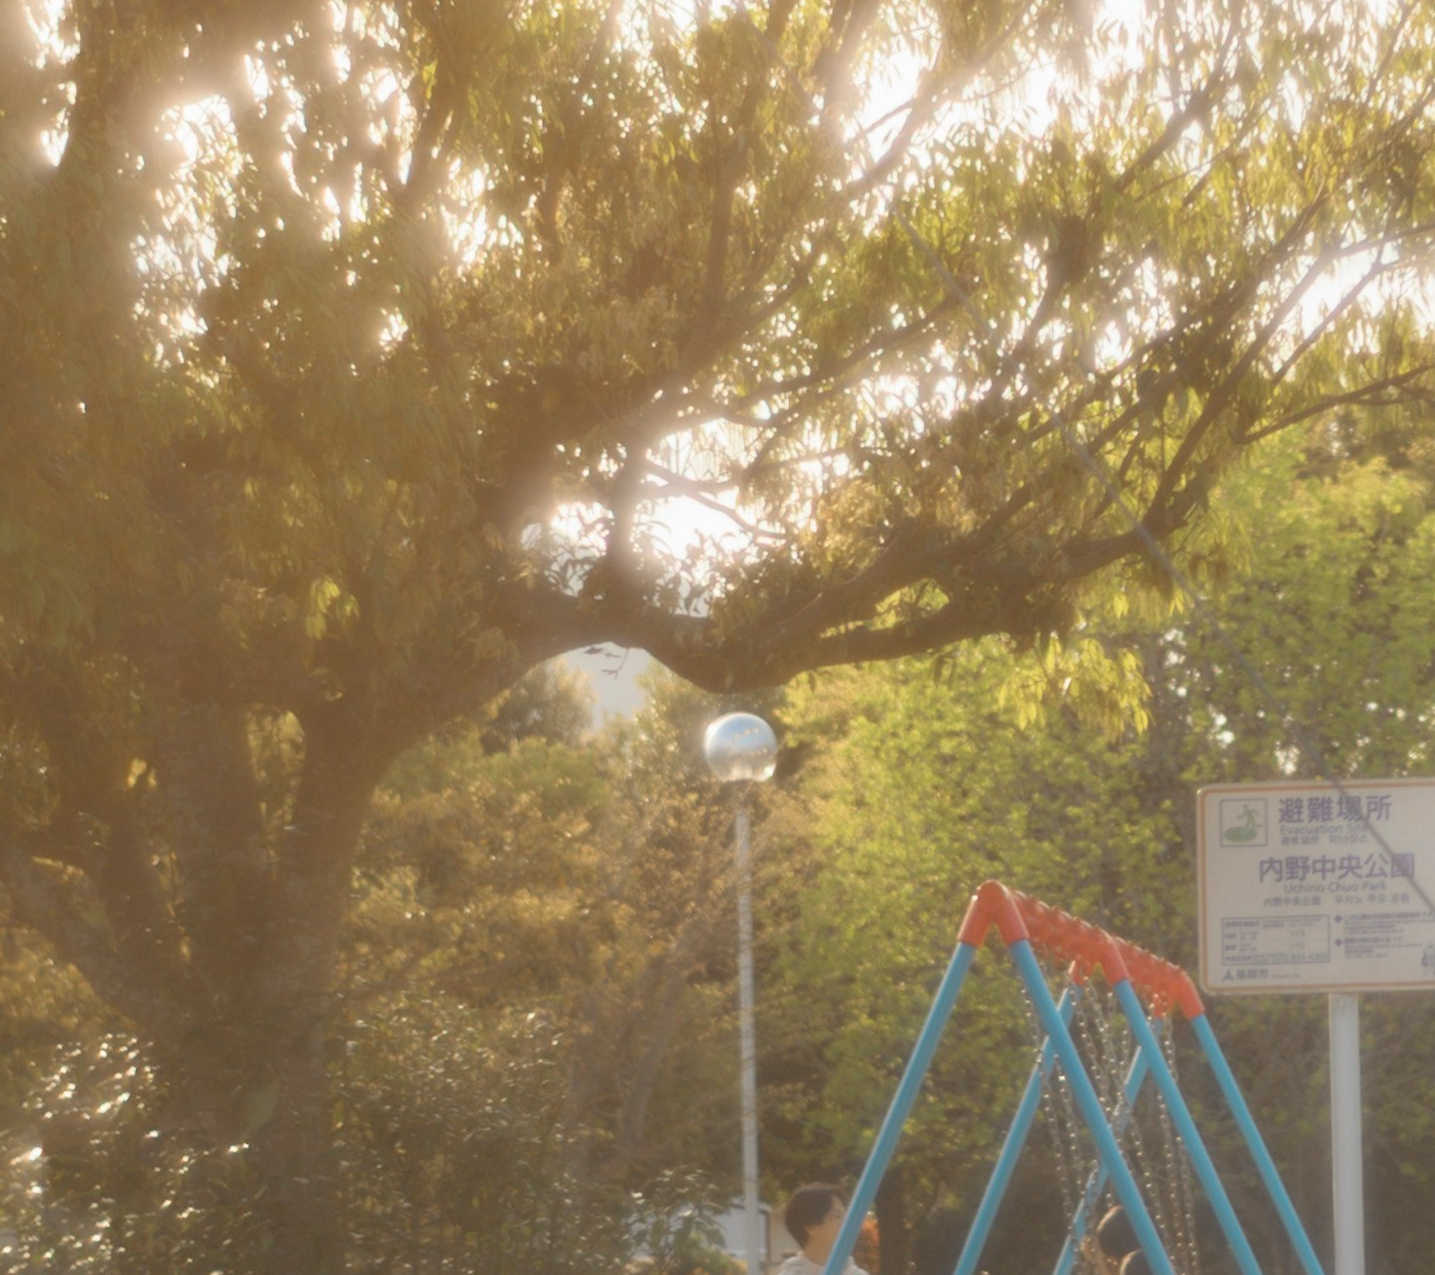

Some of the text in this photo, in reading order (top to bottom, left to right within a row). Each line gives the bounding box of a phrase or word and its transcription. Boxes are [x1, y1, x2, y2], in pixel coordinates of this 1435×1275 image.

[1278, 793, 1392, 824] 避難場所
[1279, 824, 1343, 836] Evacuation
[1259, 852, 1415, 883] 内野中央公園
[1284, 880, 1387, 894] Uchino Chuo Park
